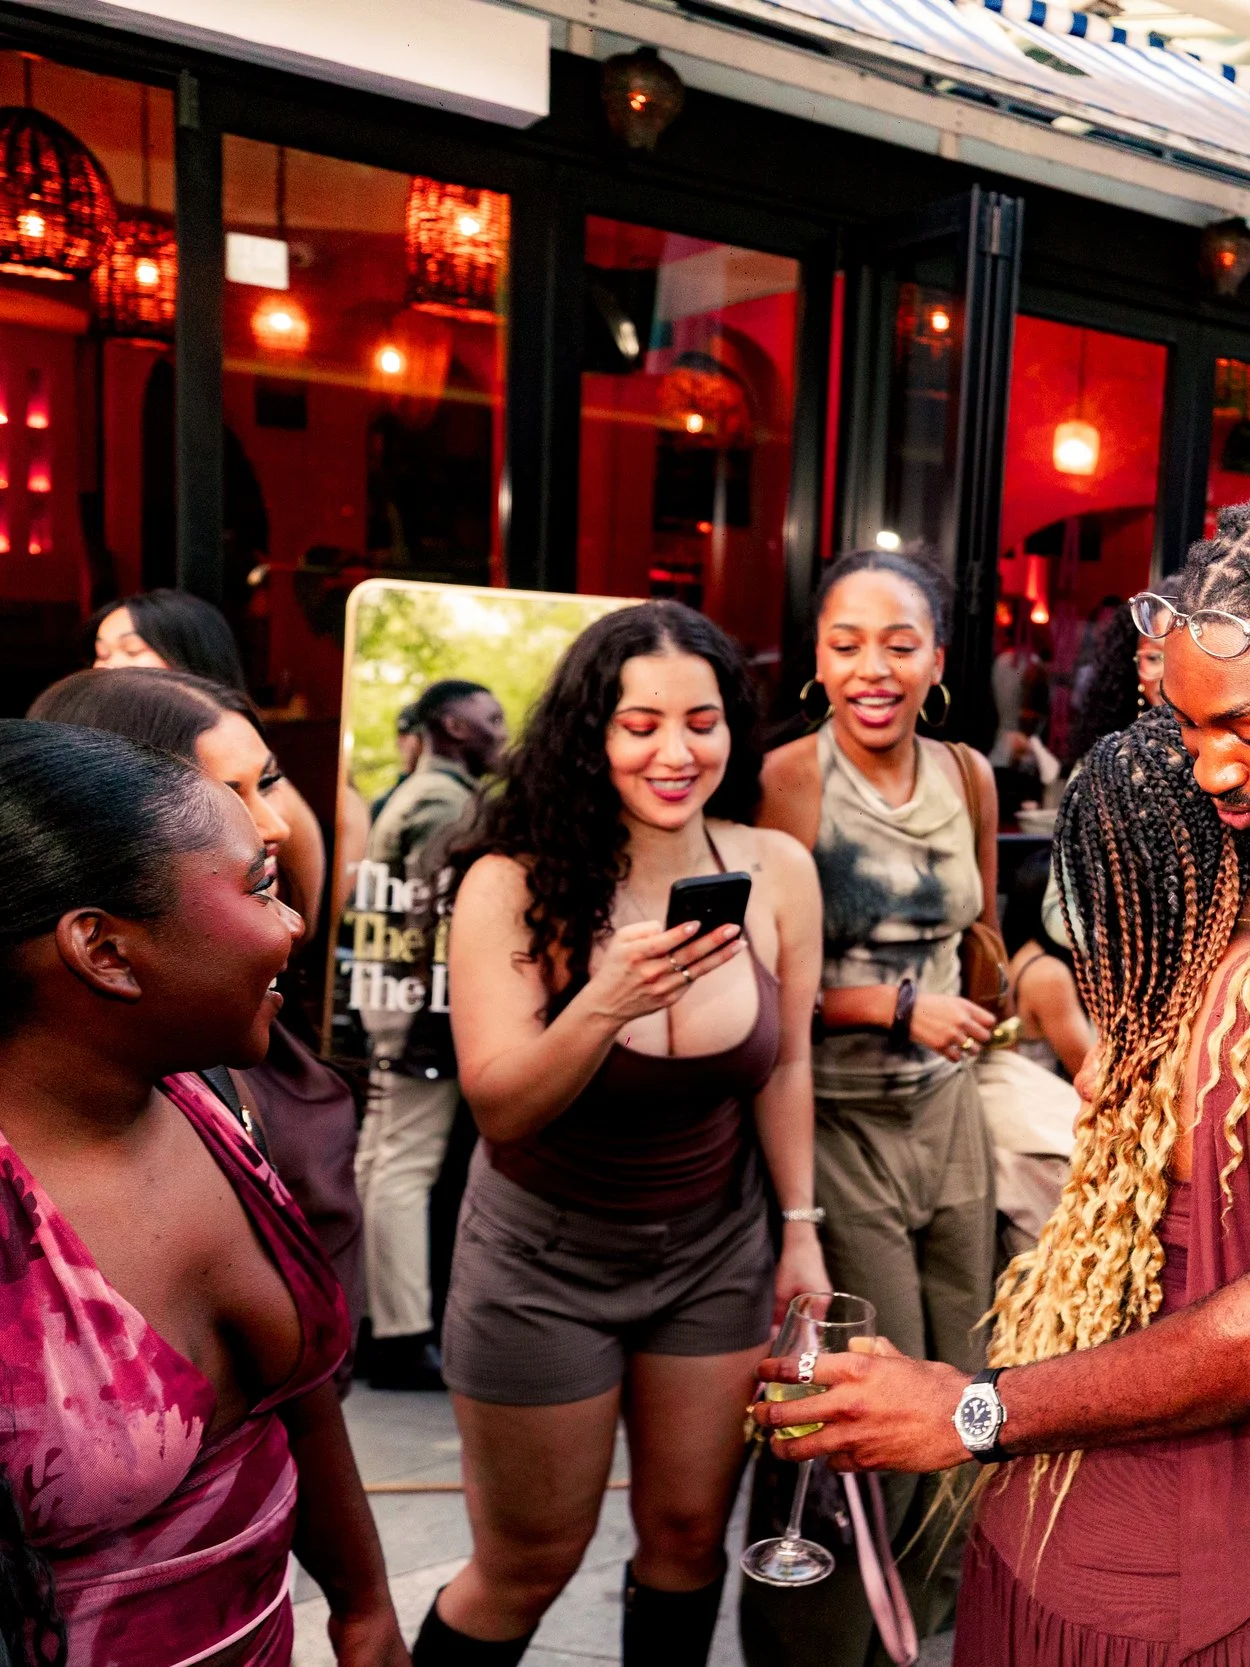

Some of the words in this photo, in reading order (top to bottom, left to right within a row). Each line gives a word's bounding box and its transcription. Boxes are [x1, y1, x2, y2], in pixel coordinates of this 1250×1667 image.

[346, 859, 431, 914] The
[343, 911, 426, 964] The
[340, 960, 426, 1013] The
